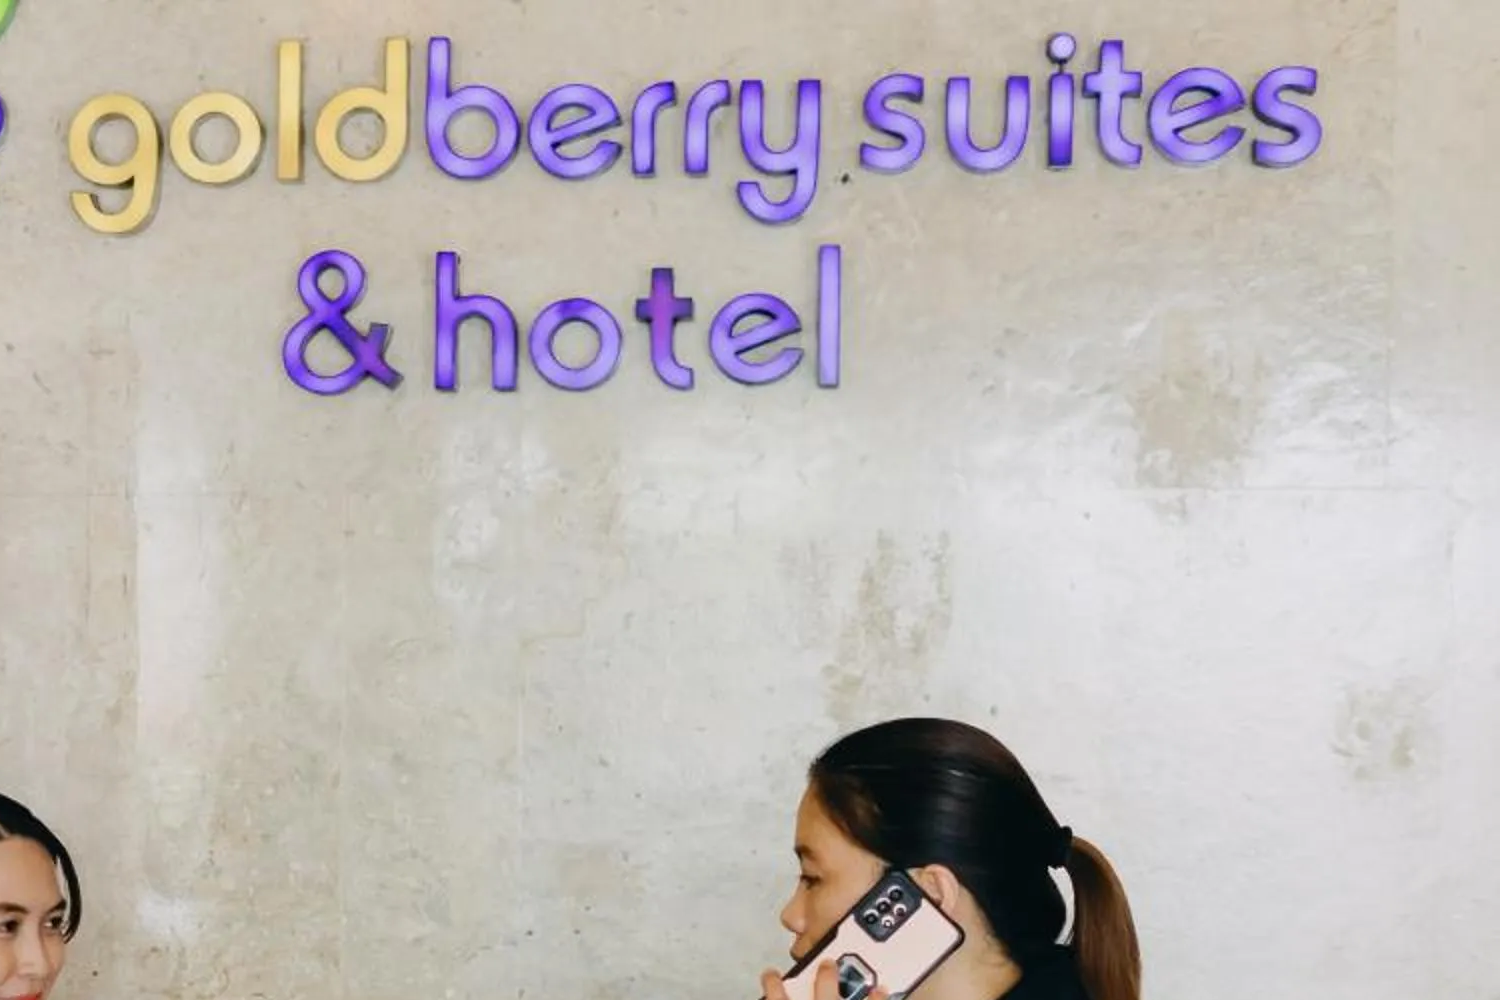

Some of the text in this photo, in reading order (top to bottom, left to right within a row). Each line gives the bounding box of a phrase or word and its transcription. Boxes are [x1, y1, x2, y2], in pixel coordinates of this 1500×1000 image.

[68, 32, 1323, 234] goldberry suites
[282, 244, 841, 395] & hotel
